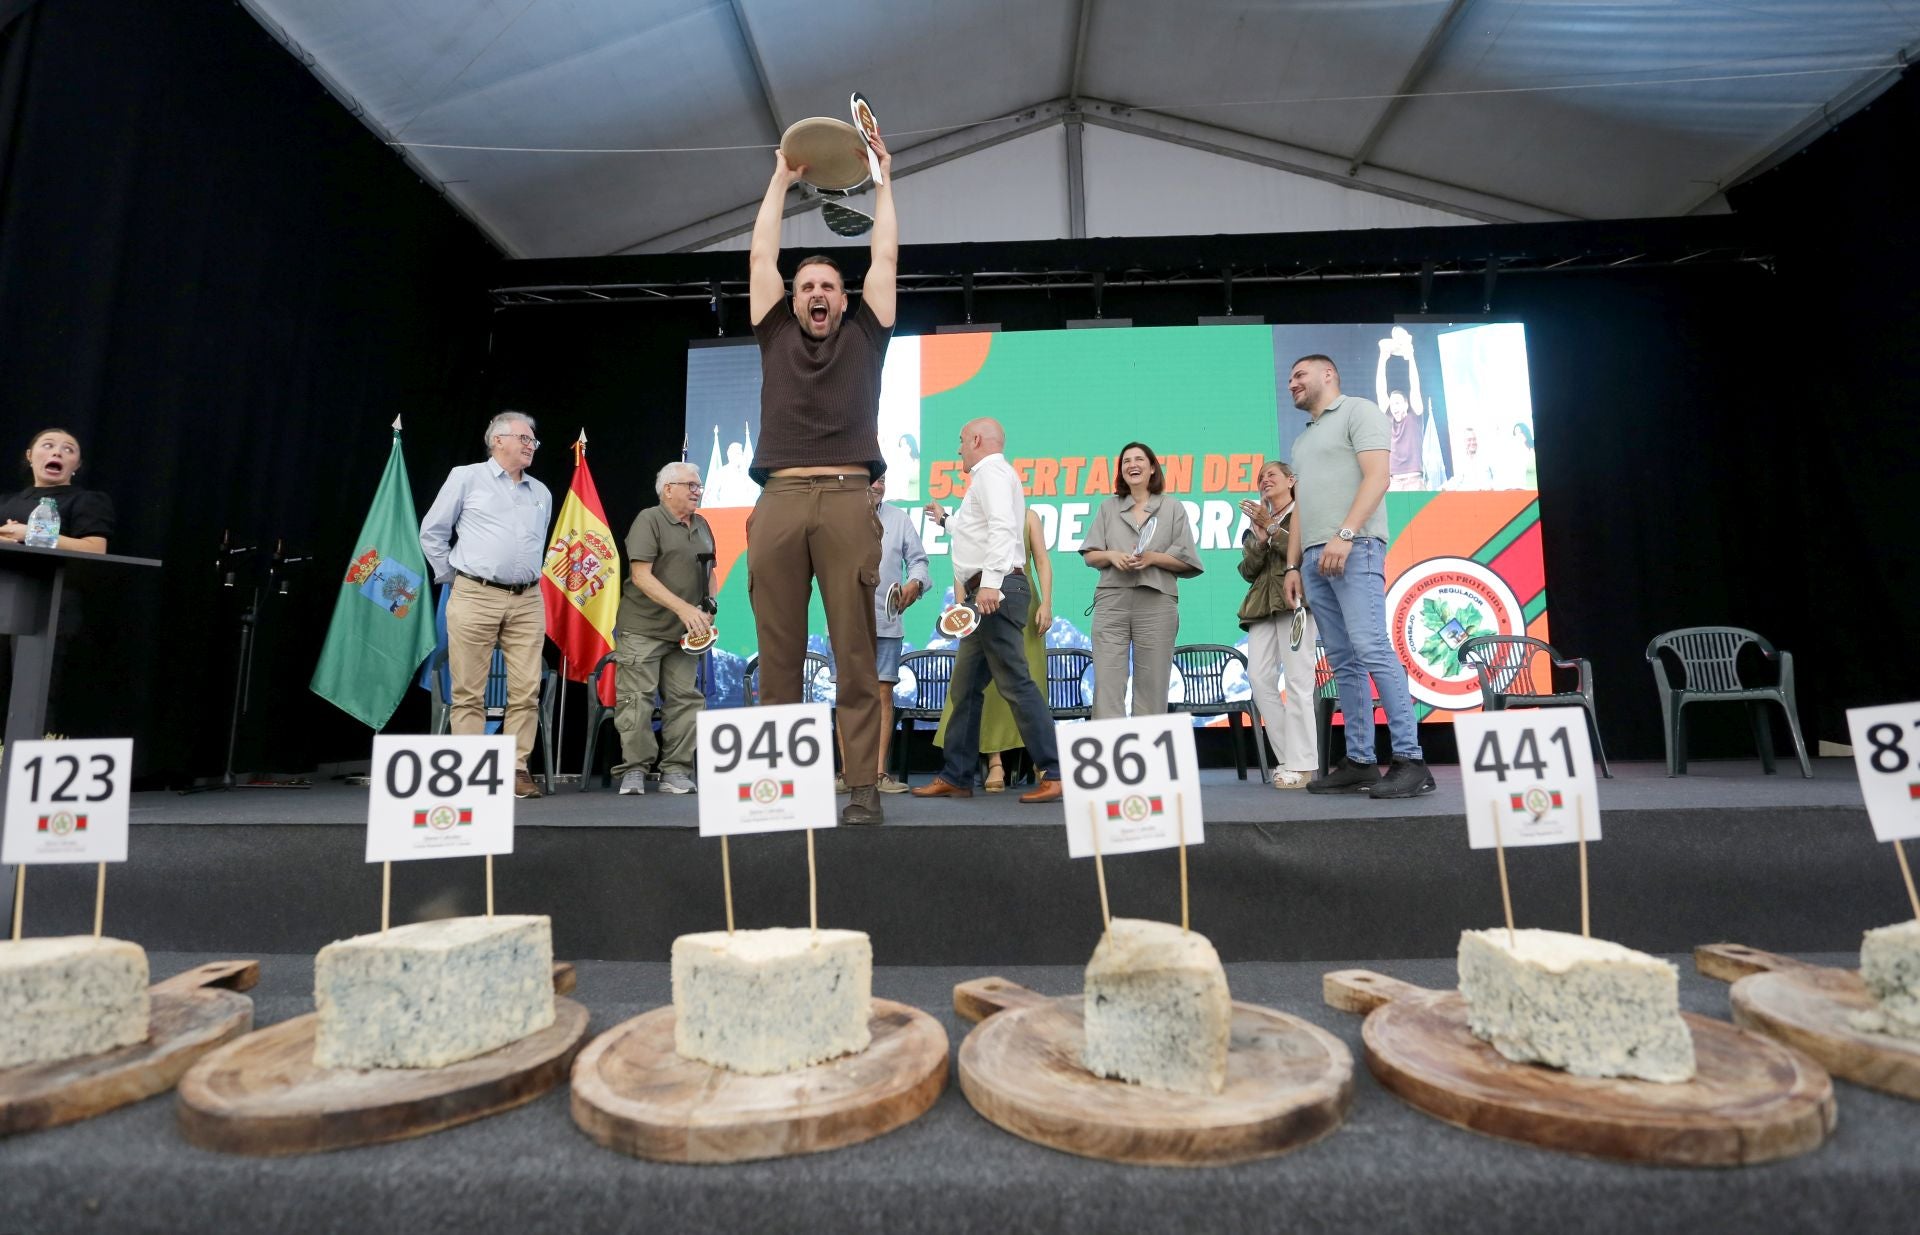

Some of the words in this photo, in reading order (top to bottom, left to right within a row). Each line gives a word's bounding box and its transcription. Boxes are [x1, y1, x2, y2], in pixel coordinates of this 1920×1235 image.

[1012, 454, 1194, 496] ERTAN
[1407, 614, 1417, 653] CONSEJO
[1438, 587, 1484, 606] REGULADOR
[1417, 574, 1454, 592] ORIGEN
[1456, 575, 1503, 613] PROTEGIDA
[711, 717, 820, 773] 946
[1071, 729, 1180, 790] 861
[1473, 726, 1576, 782] 441
[23, 752, 117, 803] 123
[385, 748, 505, 799] 084
